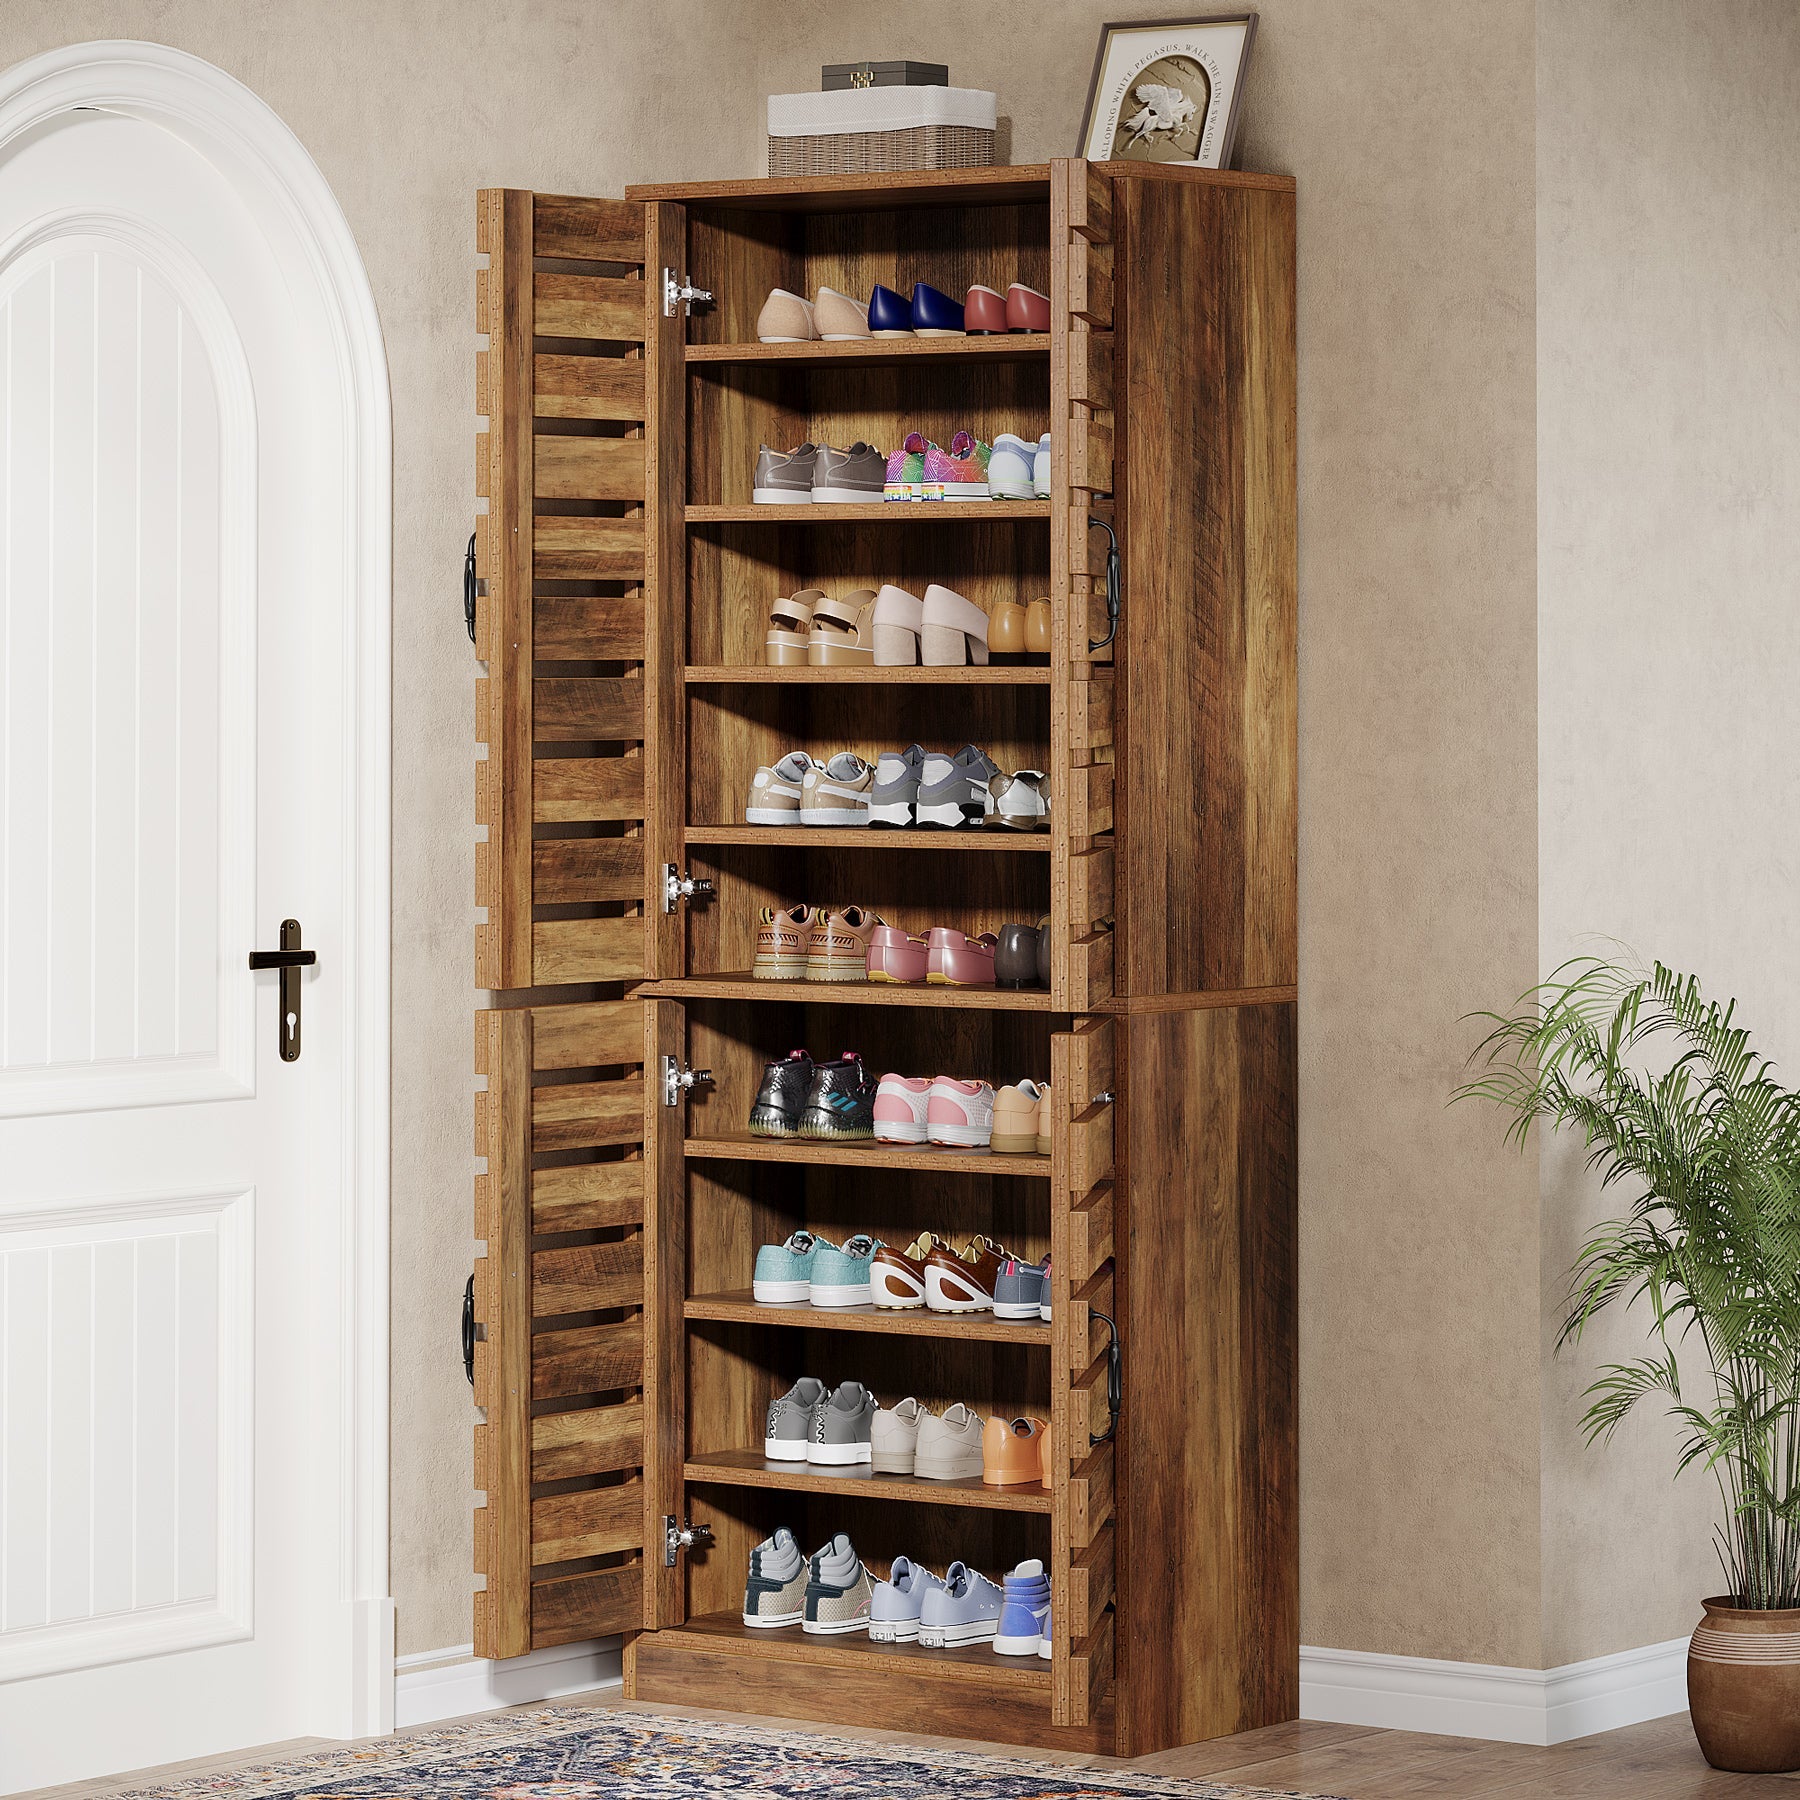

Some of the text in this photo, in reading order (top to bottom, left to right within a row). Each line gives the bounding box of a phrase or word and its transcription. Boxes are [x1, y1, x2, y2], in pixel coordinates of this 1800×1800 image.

[1185, 44, 1209, 61] WALK
[1208, 59, 1221, 79] THE
[1112, 70, 1135, 103] WHITE
[1214, 81, 1222, 106] LINE
[1201, 110, 1218, 161] SWAGGER
